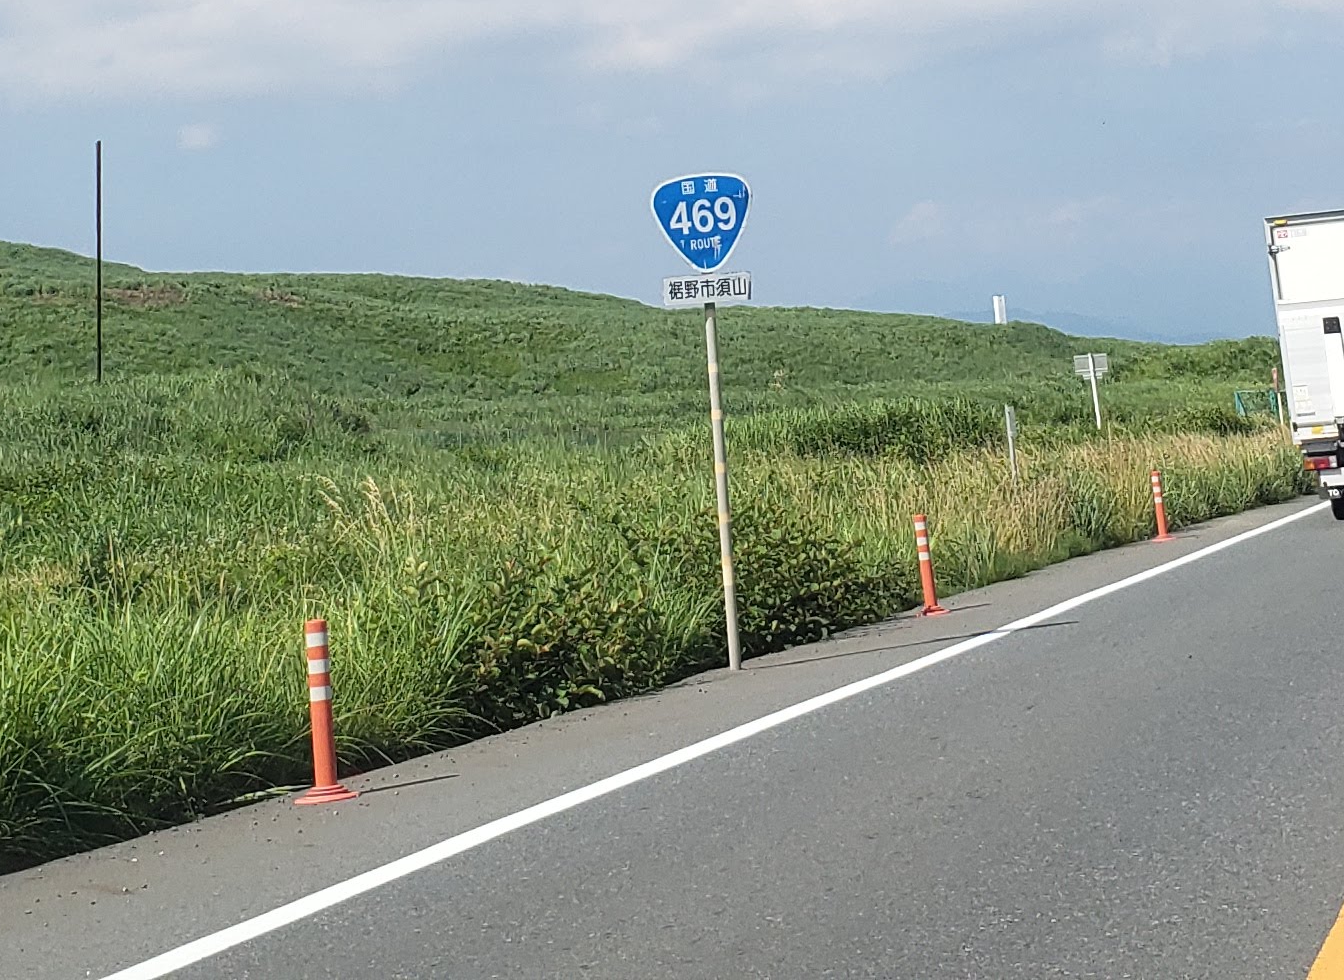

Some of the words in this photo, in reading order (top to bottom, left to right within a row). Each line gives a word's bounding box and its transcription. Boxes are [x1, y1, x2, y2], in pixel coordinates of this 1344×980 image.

[681, 178, 718, 195] 国道
[669, 196, 737, 235] 469
[690, 235, 722, 250] ROUTE
[668, 277, 747, 300] 裾野市須山
